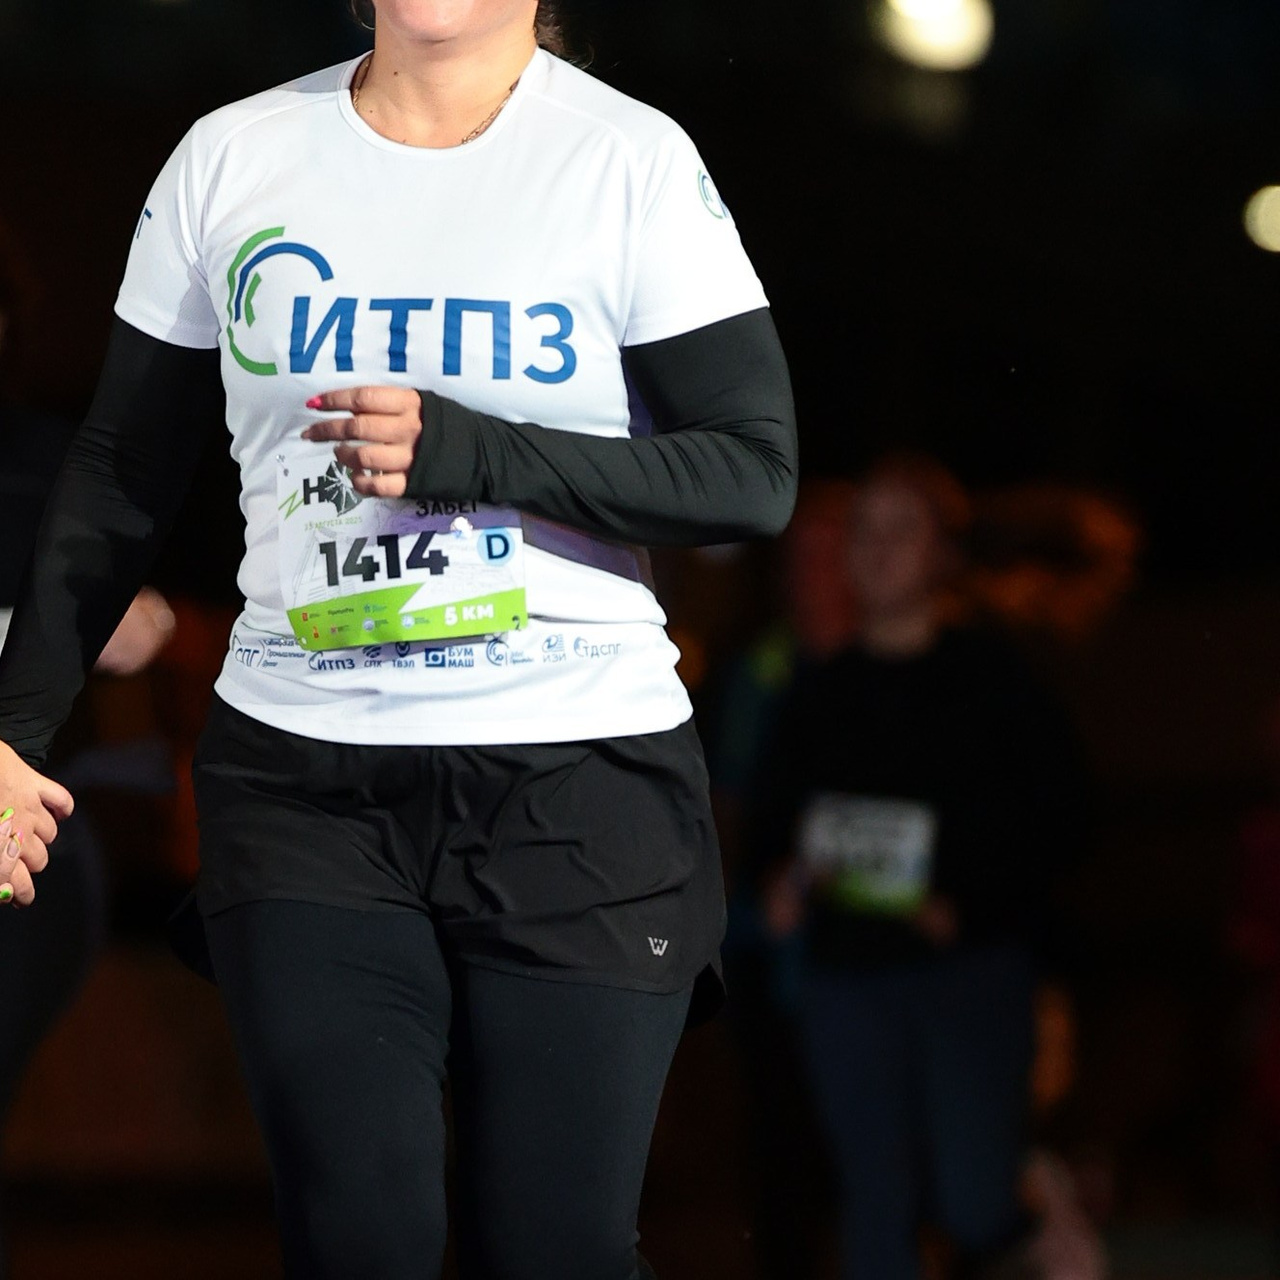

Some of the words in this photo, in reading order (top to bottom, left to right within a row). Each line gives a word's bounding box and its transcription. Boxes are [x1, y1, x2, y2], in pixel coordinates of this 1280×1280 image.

[288, 295, 577, 384] ИТПЗ
[486, 534, 510, 560] D
[320, 530, 450, 587] 1414
[444, 606, 459, 626] 5
[463, 604, 494, 620] КМ
[448, 647, 474, 657] БУМ
[317, 658, 355, 670] ИТПЗ
[448, 659, 474, 668] МАШ
